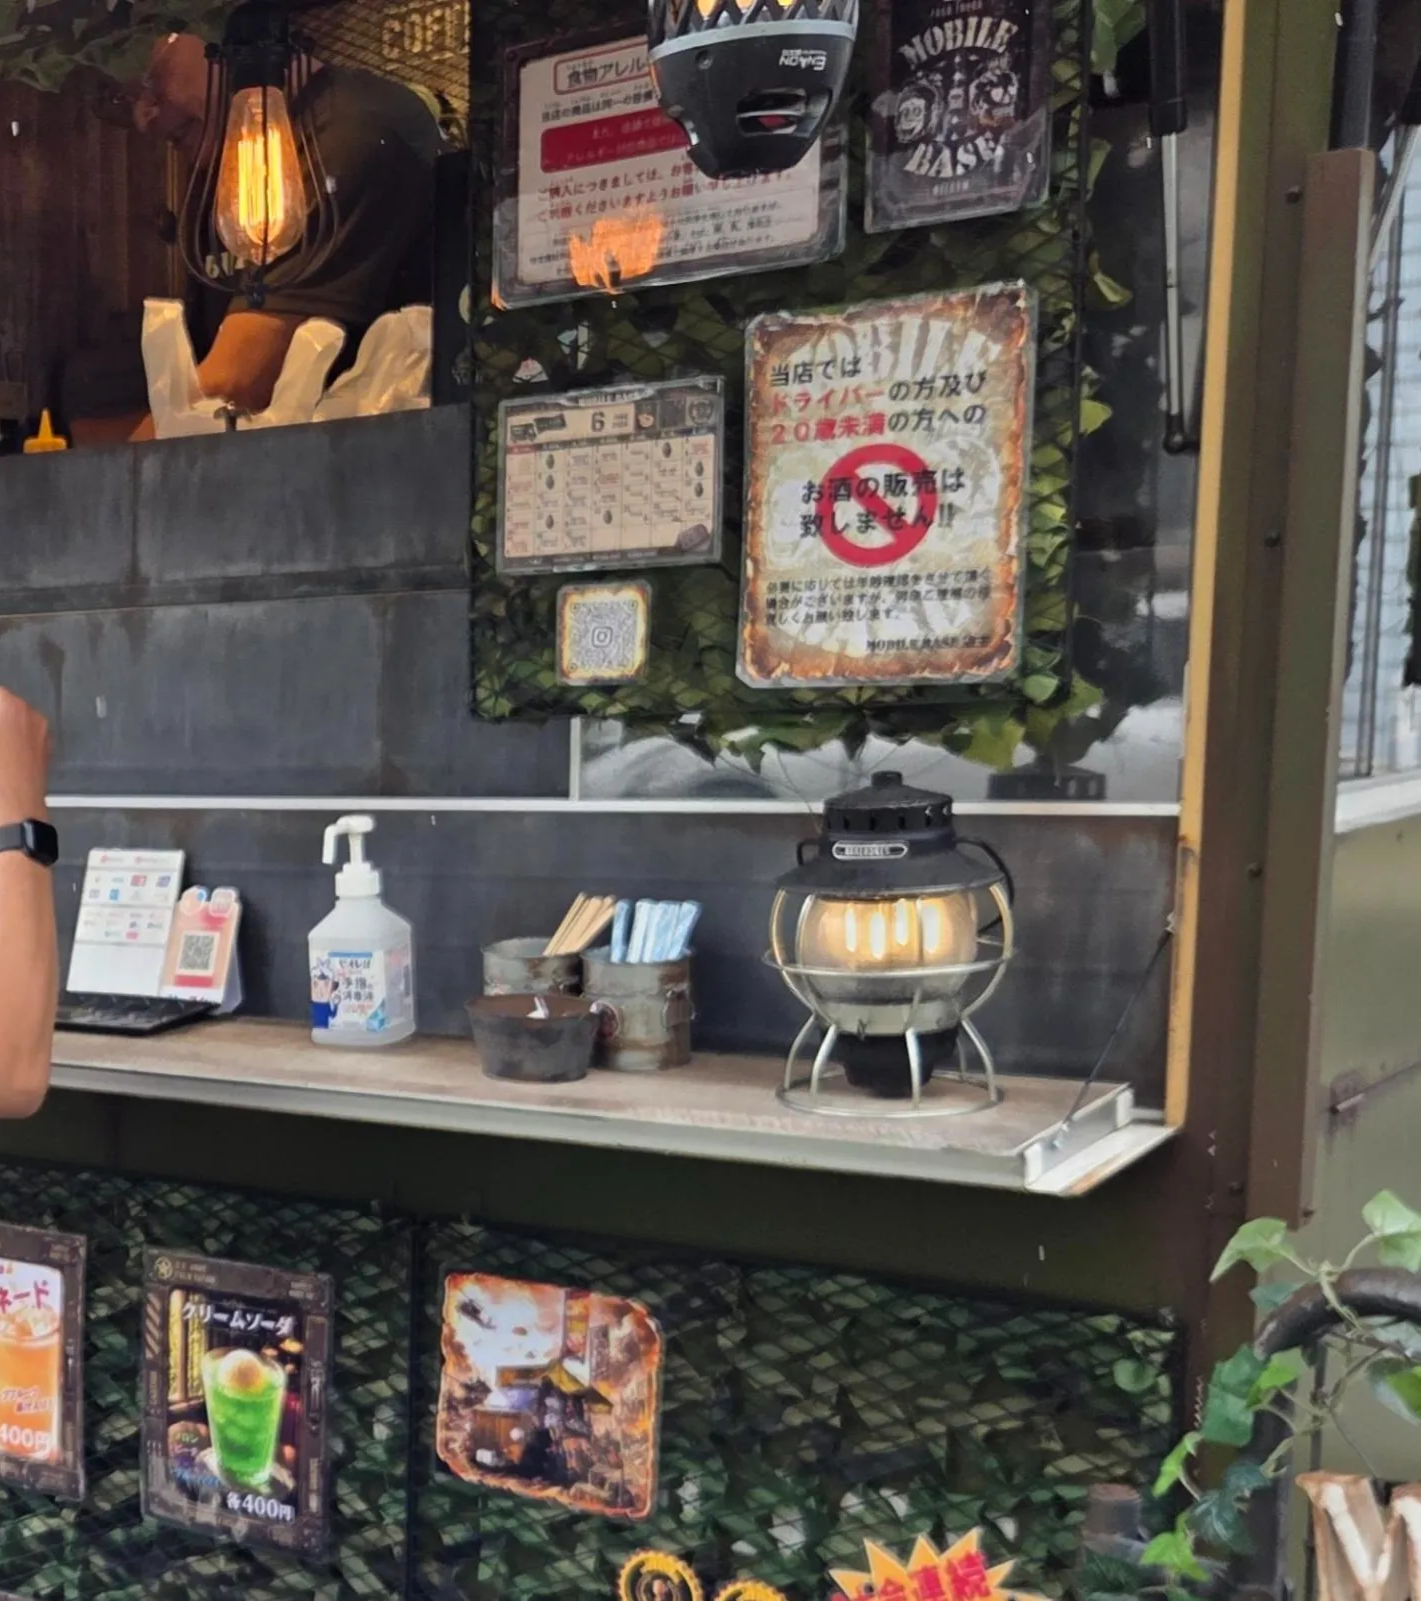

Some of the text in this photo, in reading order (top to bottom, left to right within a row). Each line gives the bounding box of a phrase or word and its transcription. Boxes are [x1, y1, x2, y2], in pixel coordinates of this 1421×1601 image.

[899, 16, 1019, 70] MOBILE
[770, 356, 862, 387] 当店では
[772, 368, 988, 413] ドライバーの方及び
[591, 411, 605, 433] 6
[801, 466, 965, 503] お酒の販売は
[182, 1301, 296, 1336] クリームソーダ
[226, 1490, 295, 1523] 各400円
